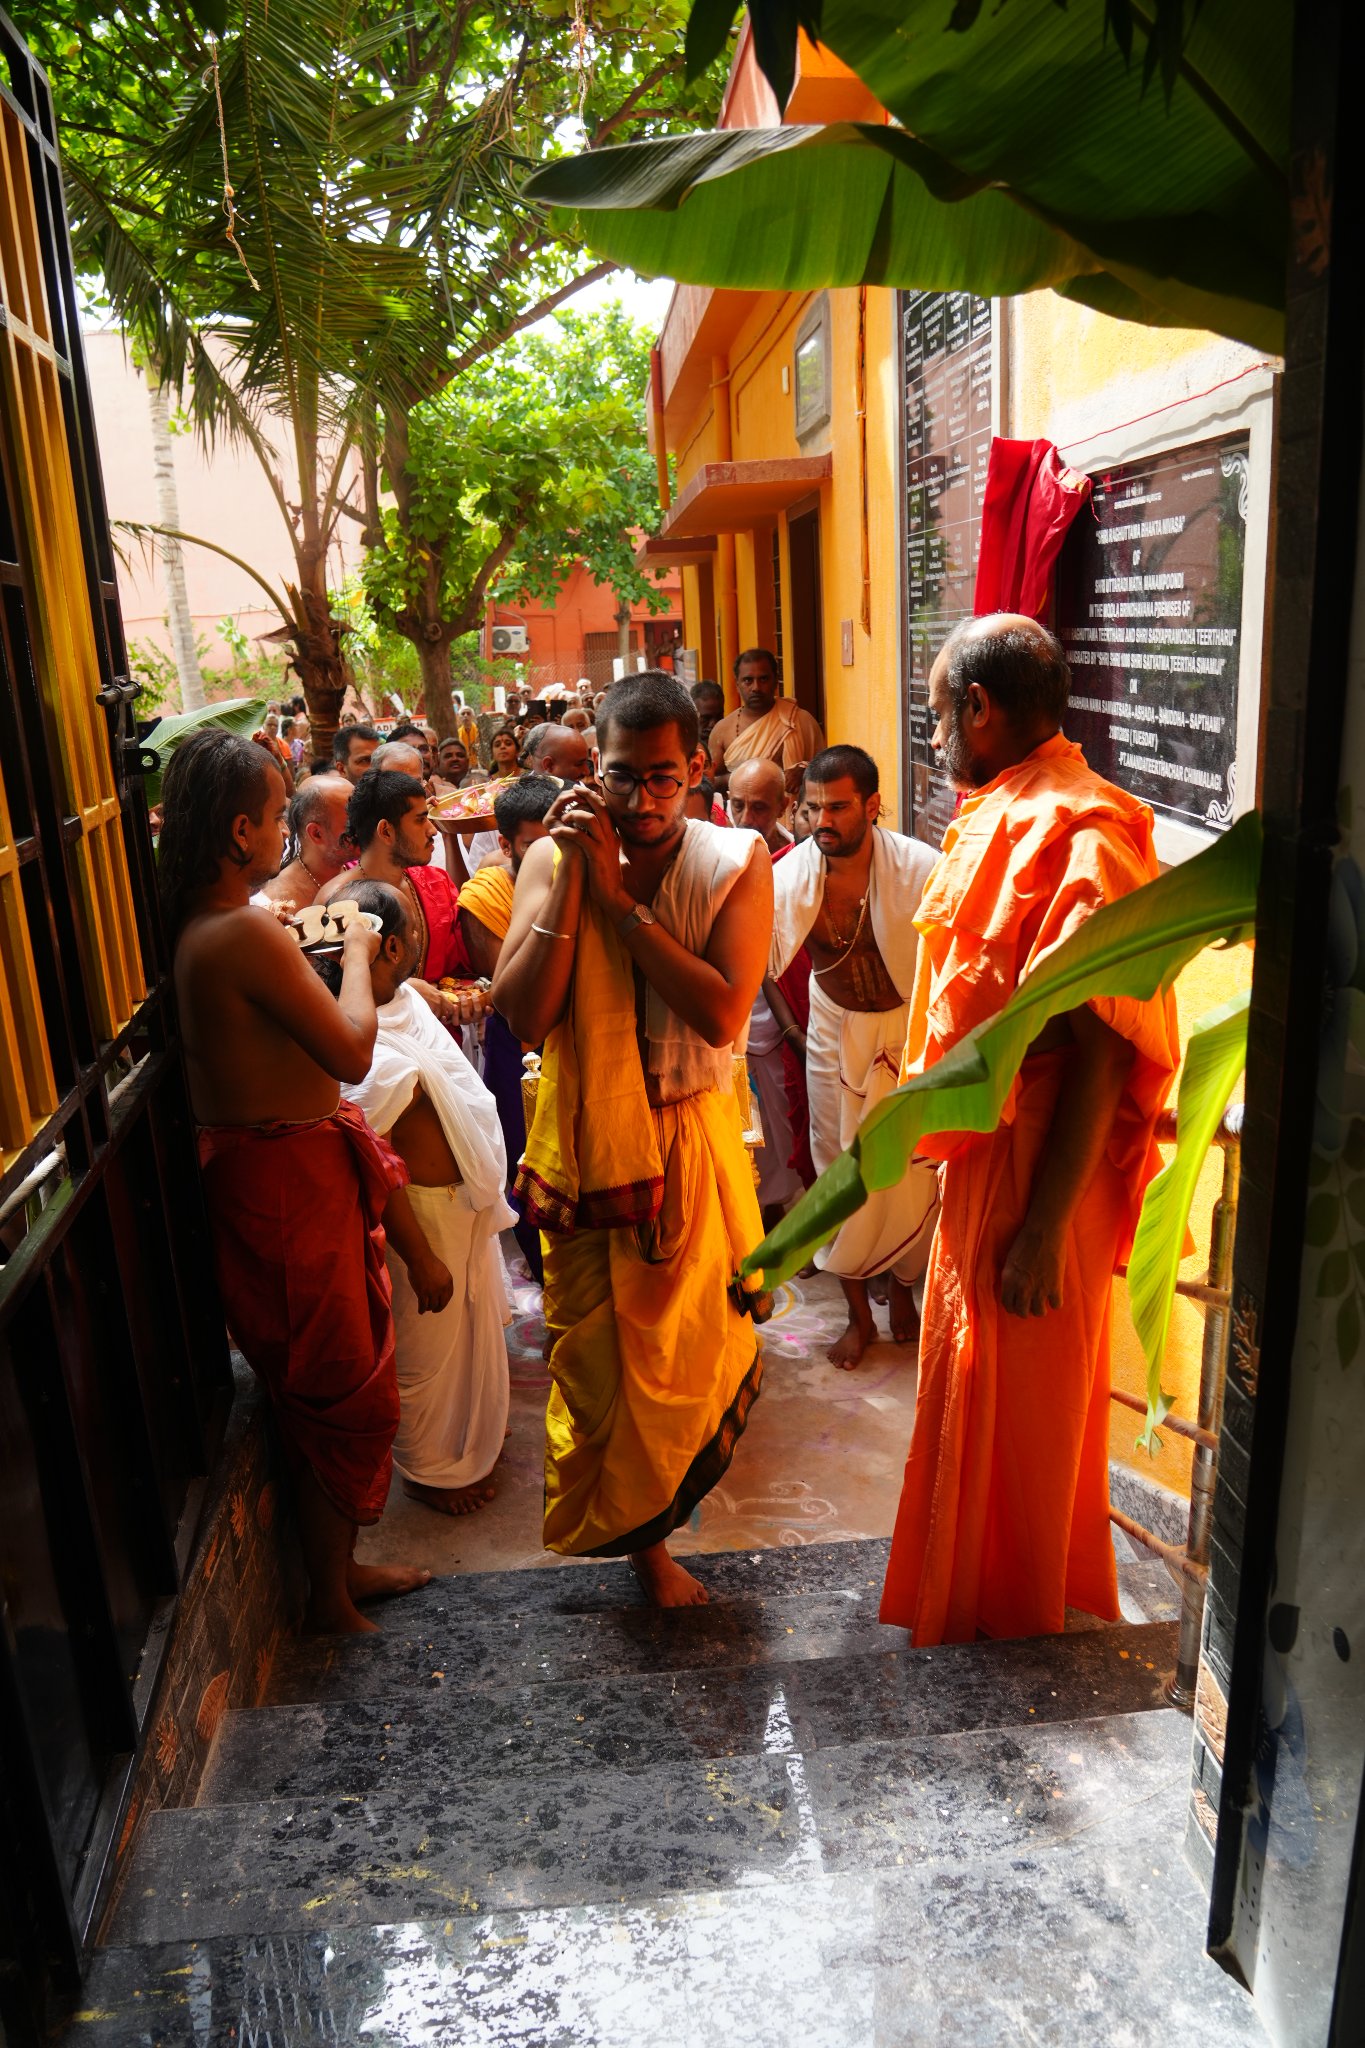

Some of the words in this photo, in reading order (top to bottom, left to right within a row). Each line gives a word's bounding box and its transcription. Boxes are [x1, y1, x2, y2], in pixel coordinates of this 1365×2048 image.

[1132, 550, 1141, 565] OF
[1182, 600, 1191, 617] OF
[1125, 628, 1136, 642] AND
